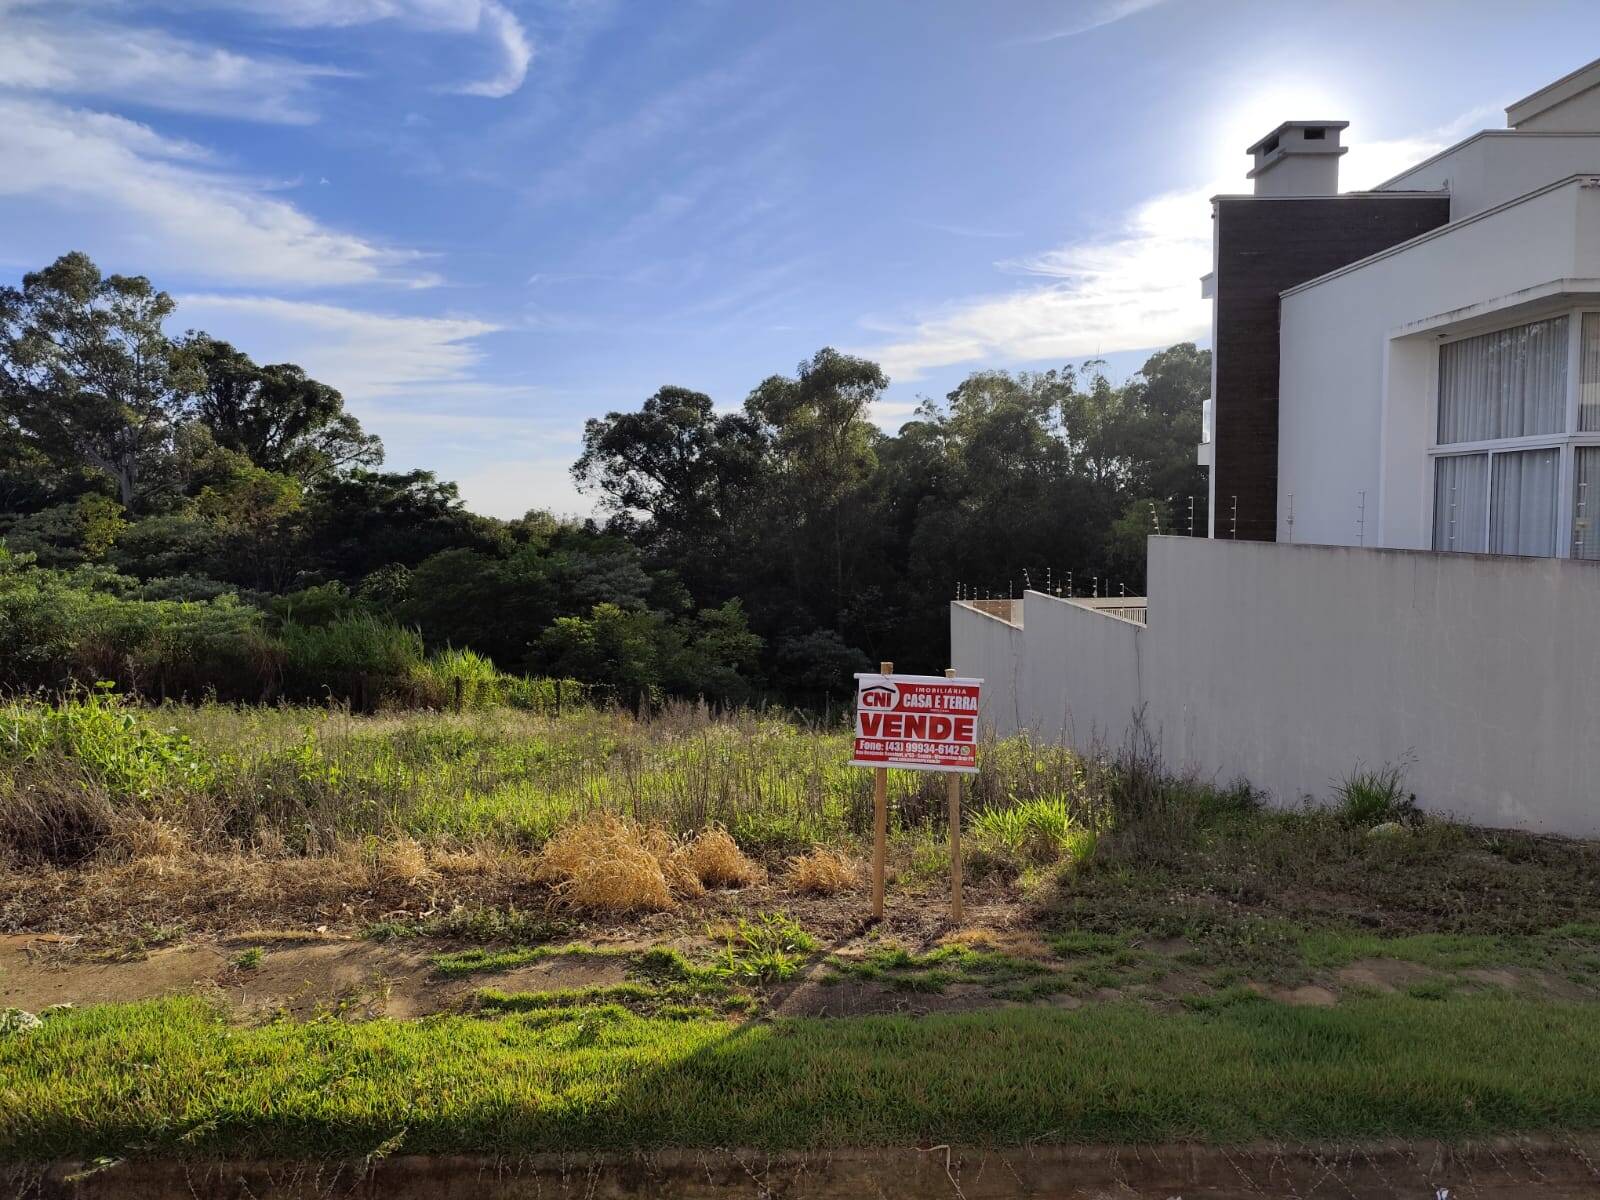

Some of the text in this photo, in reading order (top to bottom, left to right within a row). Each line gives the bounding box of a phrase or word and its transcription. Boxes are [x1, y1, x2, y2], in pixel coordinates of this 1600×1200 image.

[862, 691, 892, 707] CNI
[903, 693, 977, 711] CASA E TERRA
[860, 713, 974, 741] VENDE
[860, 740, 884, 751] Fone:
[885, 741, 904, 752] (43)
[905, 742, 960, 756] 99934-6142
